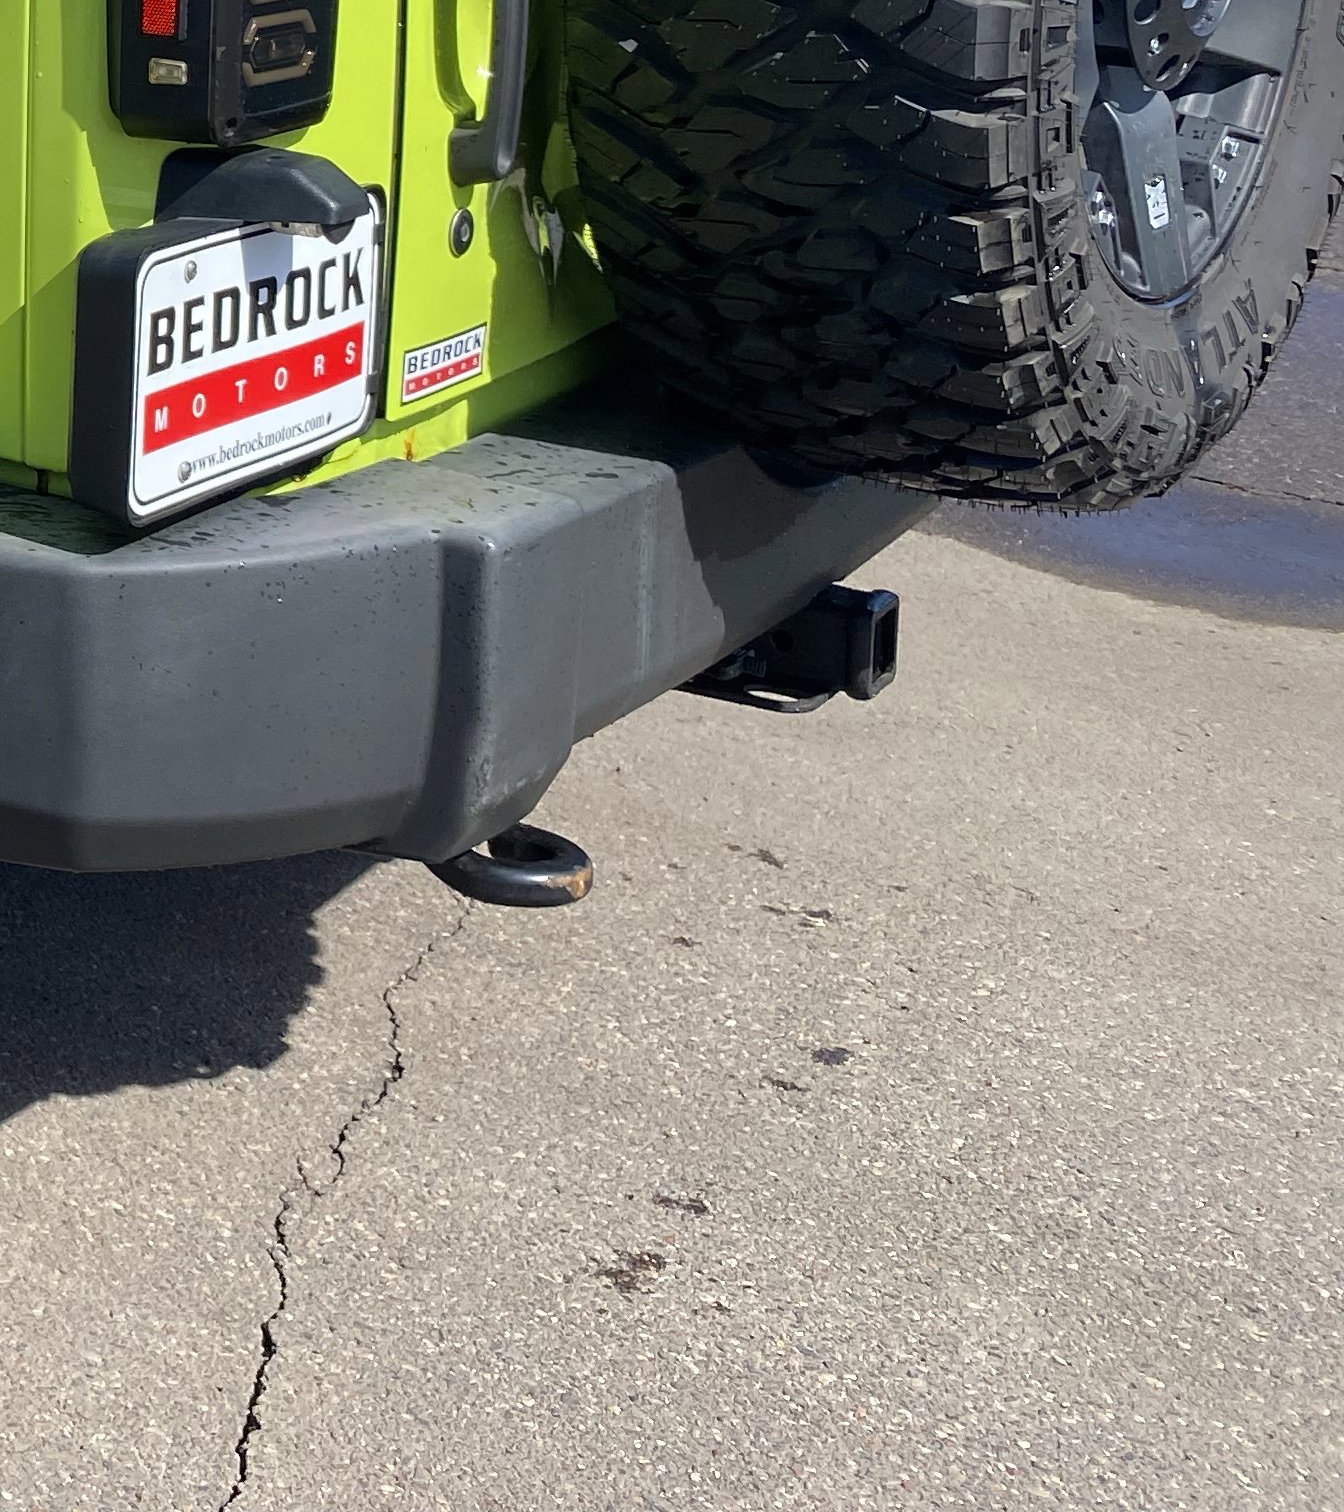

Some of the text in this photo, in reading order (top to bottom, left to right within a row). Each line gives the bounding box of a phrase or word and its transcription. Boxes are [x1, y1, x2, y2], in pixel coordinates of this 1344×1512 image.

[146, 246, 366, 378] BEDROCK
[407, 331, 482, 375] BEDROCK
[154, 341, 356, 433] MOTORS
